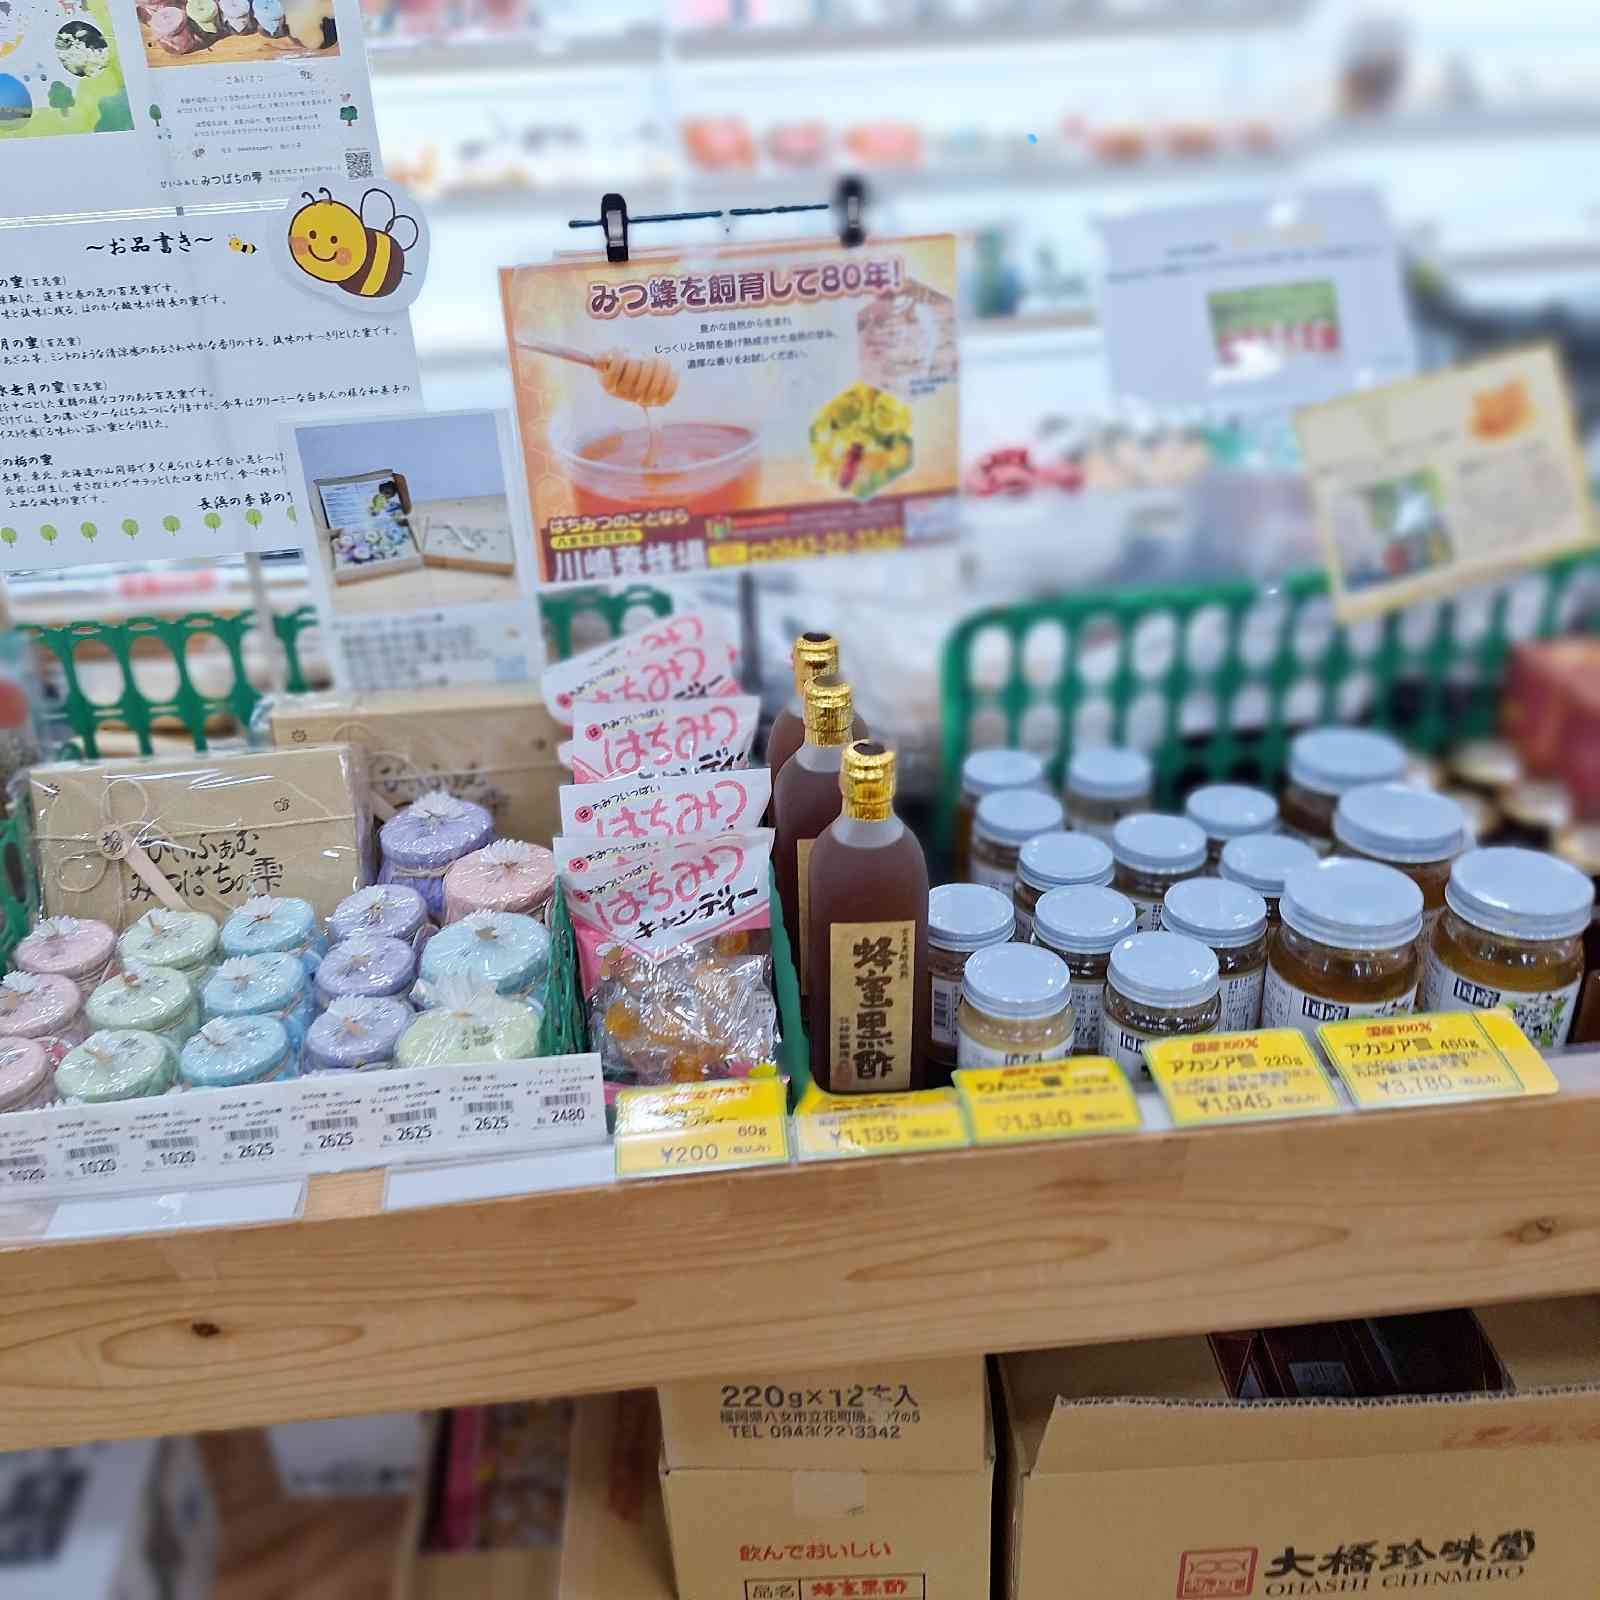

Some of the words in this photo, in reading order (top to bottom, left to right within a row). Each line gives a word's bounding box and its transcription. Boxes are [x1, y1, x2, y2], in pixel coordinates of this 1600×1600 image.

[595, 844, 745, 932] はちみつ
[635, 885, 759, 939] キャンディー
[659, 1142, 720, 1164] ¥200
[728, 1424, 764, 1440] TEL
[738, 1541, 893, 1563] 飲んでおいしい
